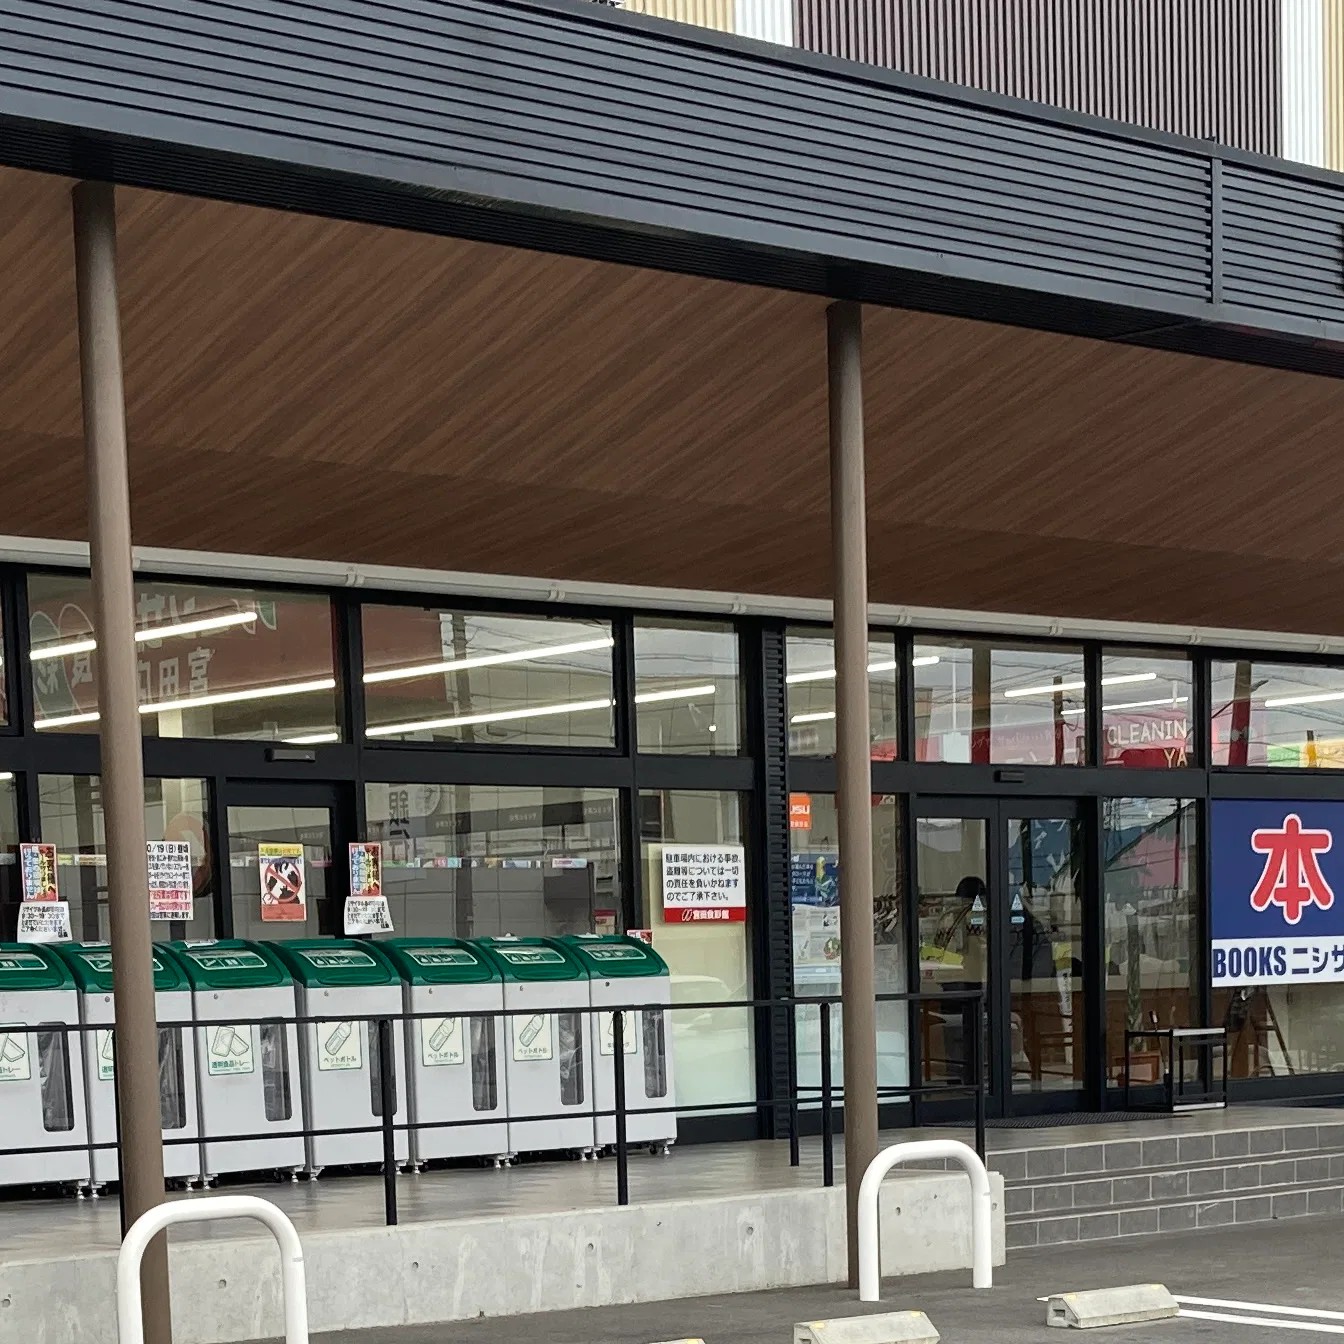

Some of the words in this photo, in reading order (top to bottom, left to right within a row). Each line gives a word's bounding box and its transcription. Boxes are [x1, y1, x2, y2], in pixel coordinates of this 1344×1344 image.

[1106, 718, 1188, 745] CLEANIN
[666, 878, 739, 888] の責任を負いかねます
[1250, 813, 1335, 925] 本
[1213, 945, 1287, 979] BOOKS
